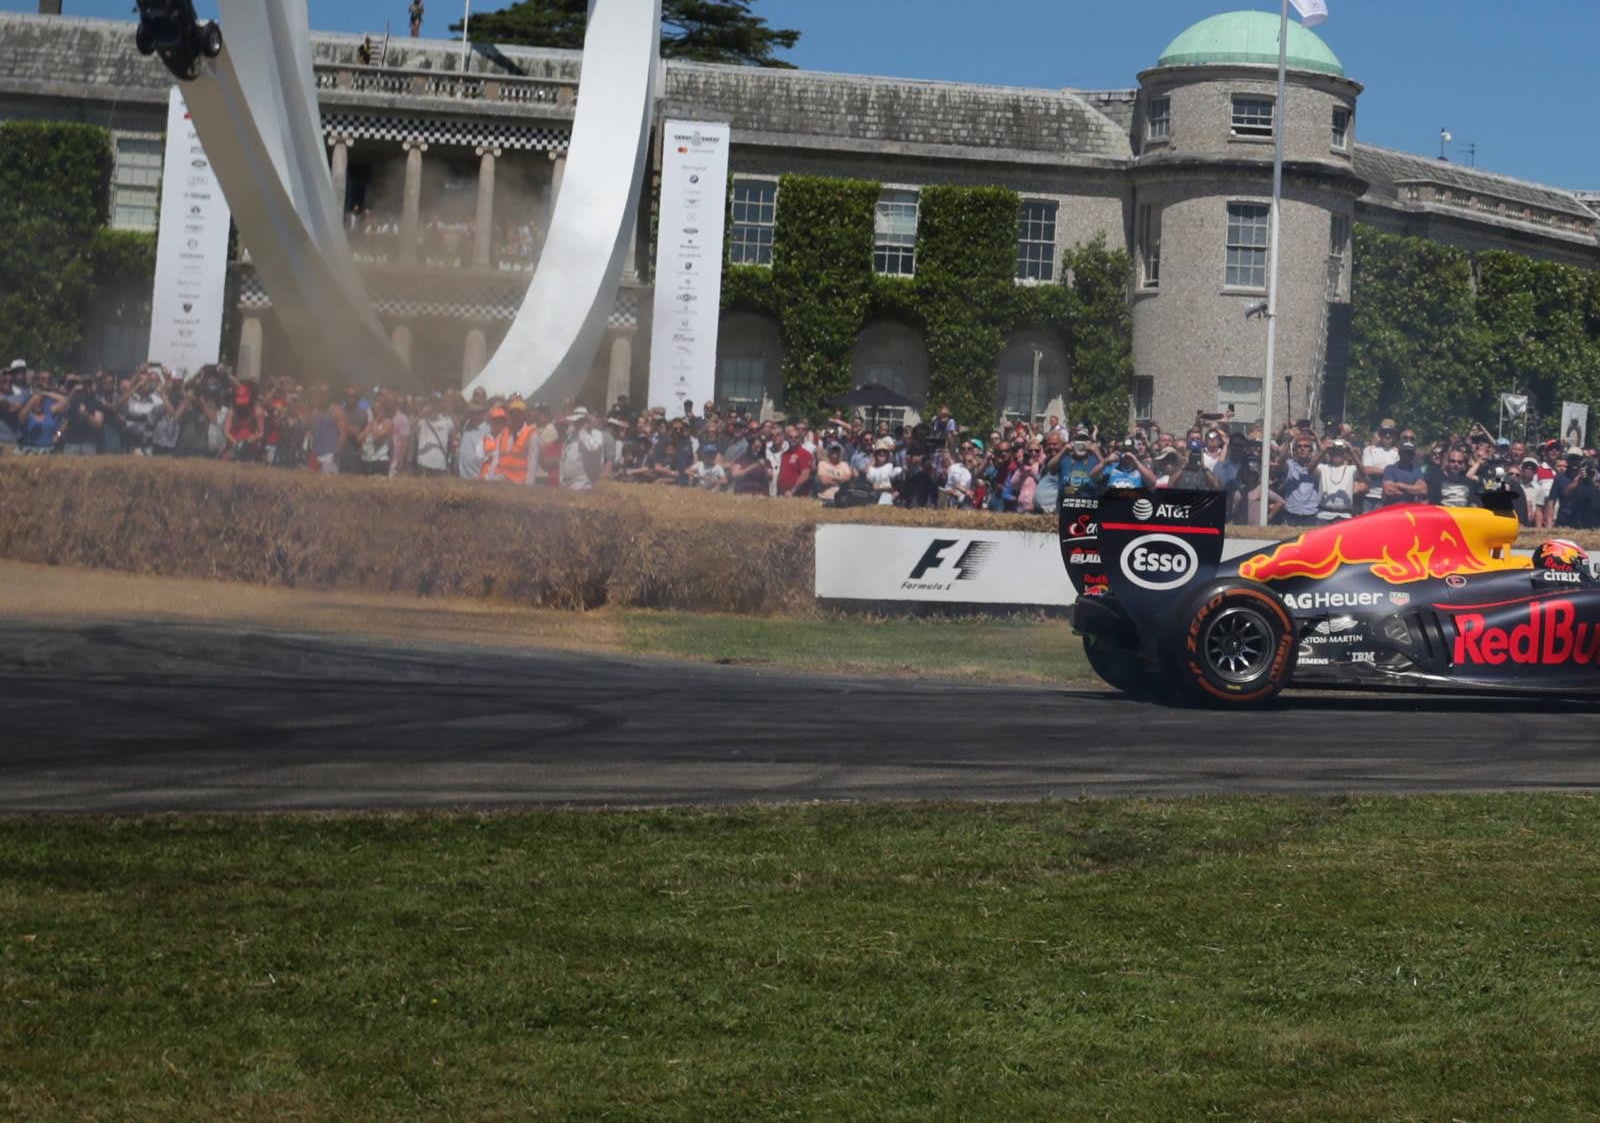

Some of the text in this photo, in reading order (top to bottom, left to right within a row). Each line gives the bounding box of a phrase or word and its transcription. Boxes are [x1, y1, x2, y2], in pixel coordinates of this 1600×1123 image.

[1156, 504, 1191, 518] AT&T
[1133, 548, 1187, 573] Esso
[1280, 591, 1384, 609] AGHeuer
[1301, 634, 1363, 644] STON MARTIN
[1352, 651, 1375, 663] IBM
